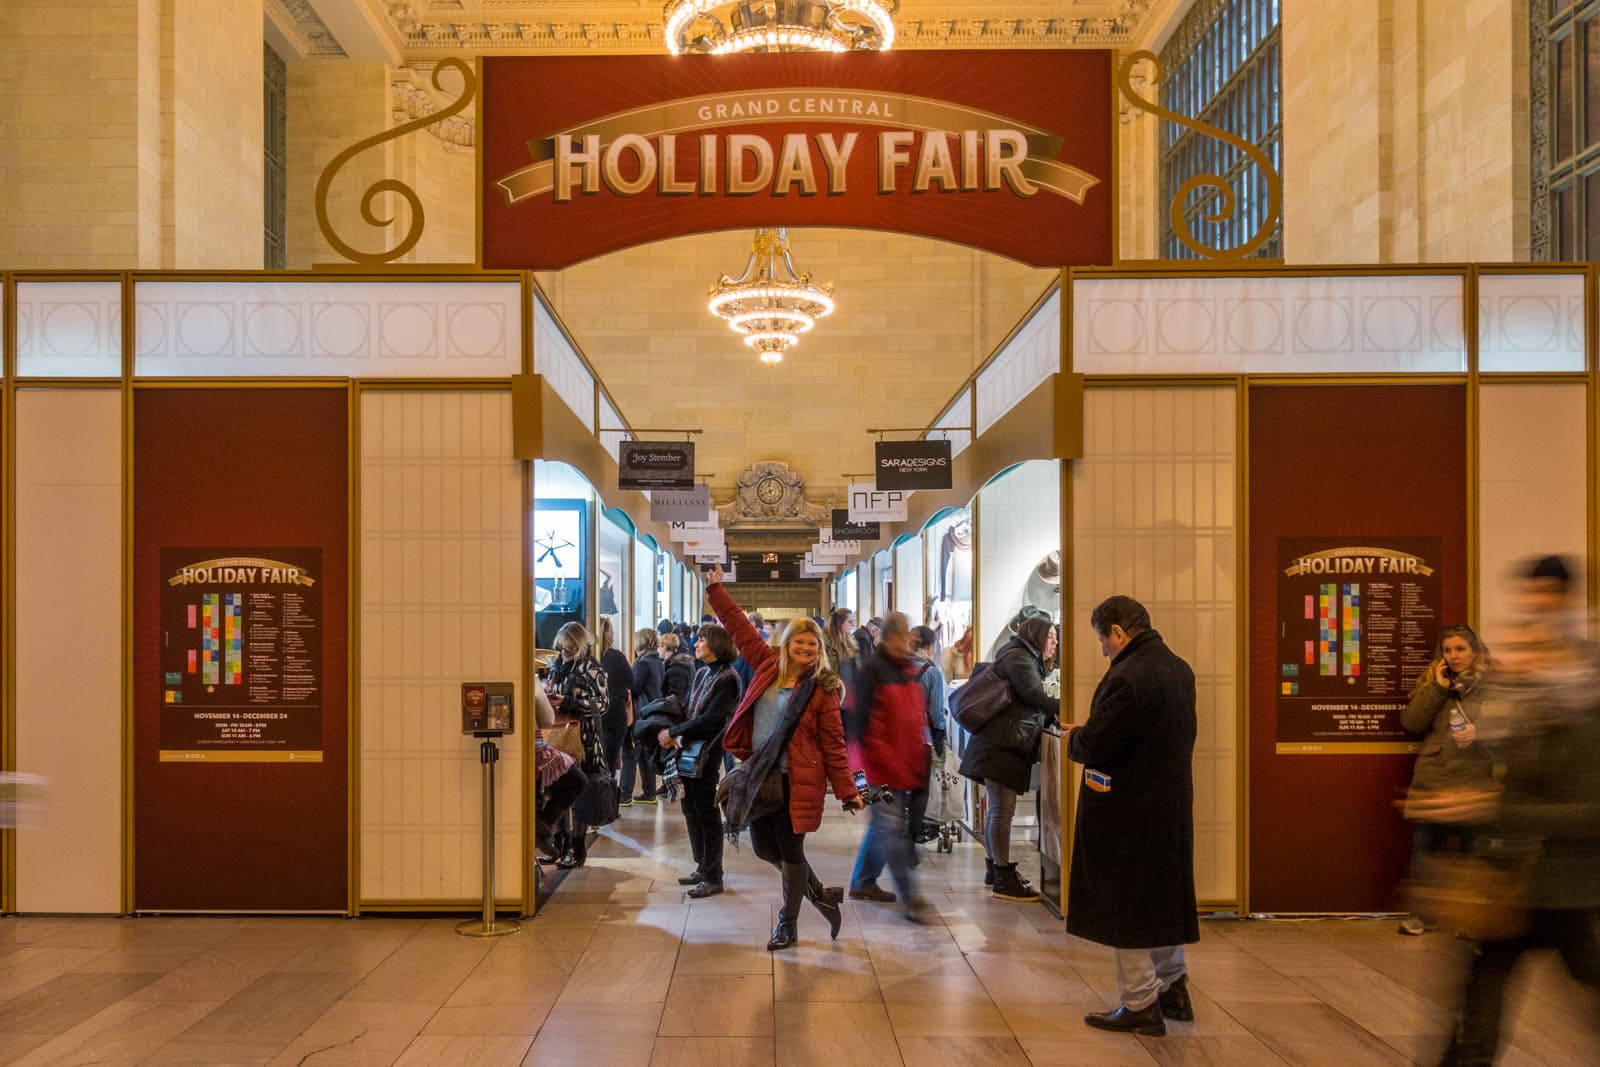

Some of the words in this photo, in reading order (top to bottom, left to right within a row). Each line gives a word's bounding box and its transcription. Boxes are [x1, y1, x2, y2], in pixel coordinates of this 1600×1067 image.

[699, 100, 780, 121] GRAND
[788, 98, 894, 118] CENTRAL
[553, 132, 859, 204] HOLIDAY
[877, 129, 1040, 199] FAIR
[632, 453, 647, 464] Joy
[648, 453, 682, 462] Stember
[1300, 558, 1375, 575] HOLIDAY
[1379, 558, 1419, 574] FAIR
[182, 568, 257, 585] HOLIDAY
[261, 568, 300, 585] FAIR
